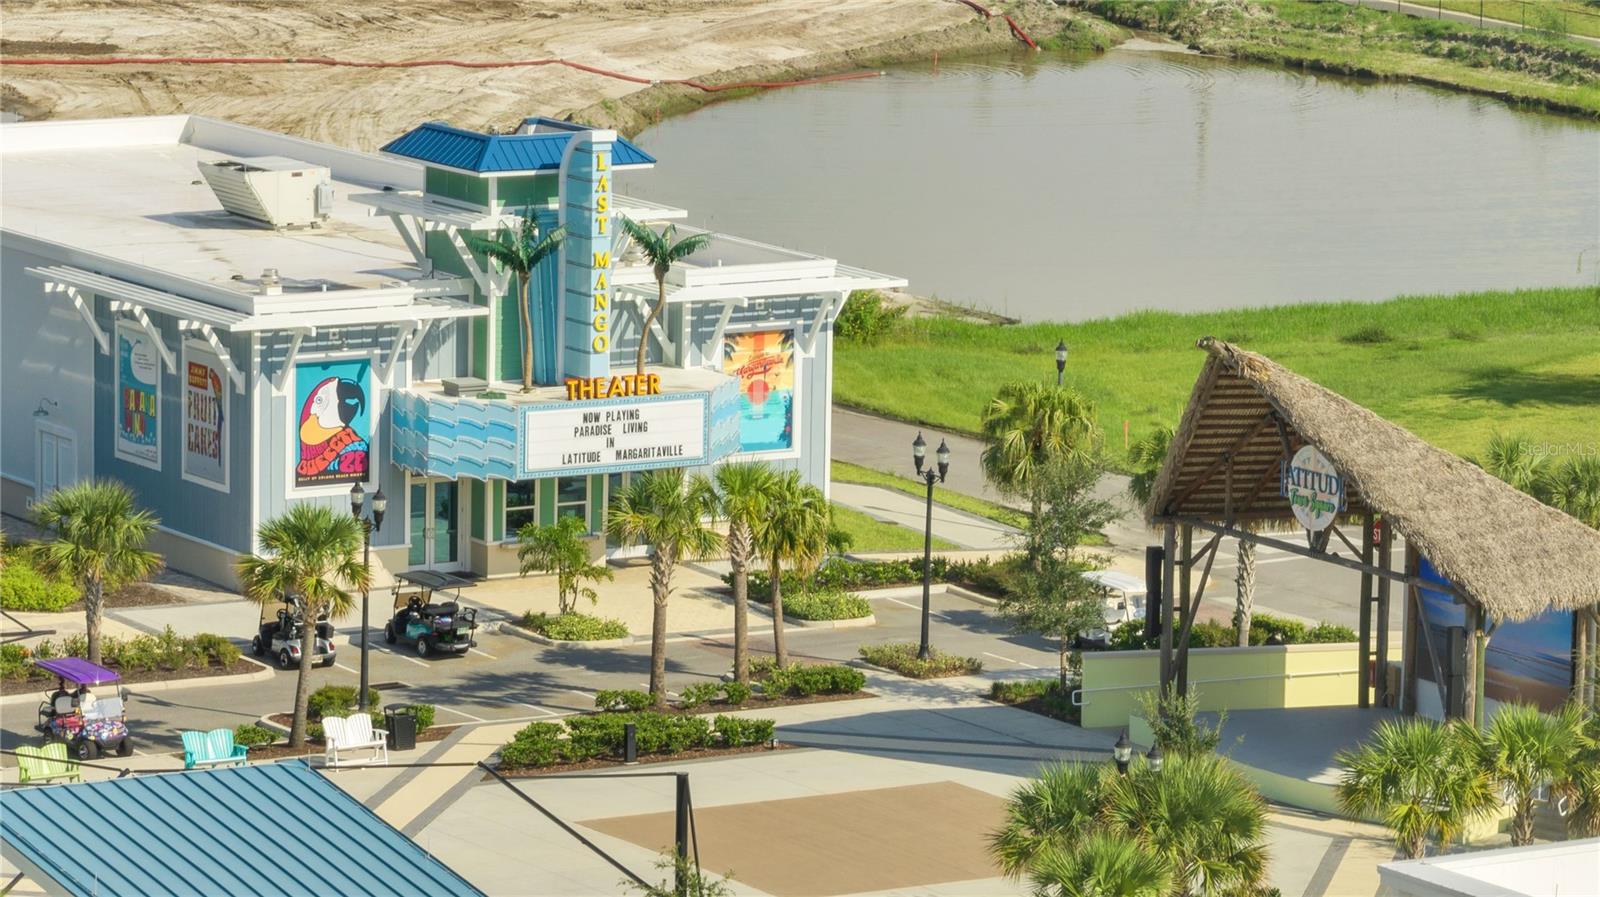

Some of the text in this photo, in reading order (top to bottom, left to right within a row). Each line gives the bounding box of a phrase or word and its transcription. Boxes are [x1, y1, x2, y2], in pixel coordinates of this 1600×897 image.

[592, 152, 610, 353] LAST MANGO
[565, 373, 661, 400] THEATER
[188, 390, 217, 425] FRUIT
[583, 409, 640, 424] NOW PLAYING
[574, 421, 648, 438] PARADISE LIVING
[606, 437, 615, 448] IN
[562, 445, 683, 465] LATITUDE MARGARITAVILLE
